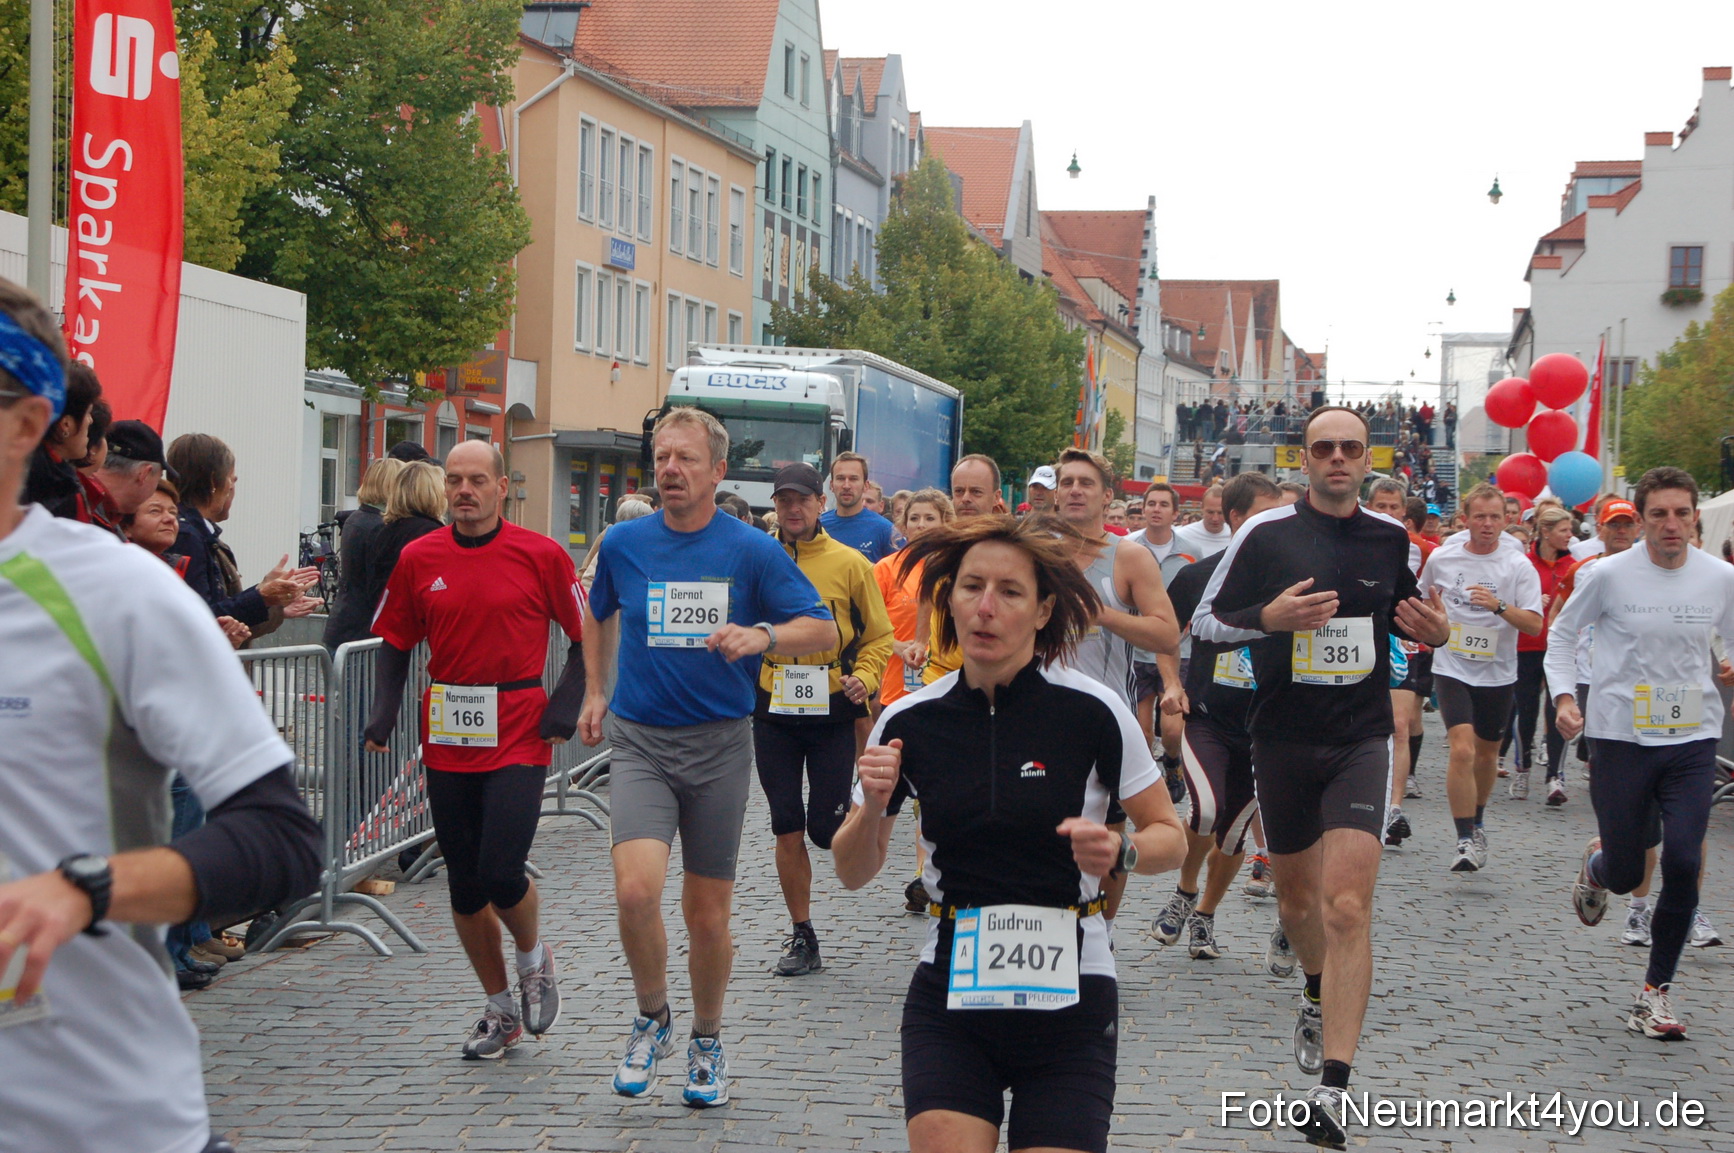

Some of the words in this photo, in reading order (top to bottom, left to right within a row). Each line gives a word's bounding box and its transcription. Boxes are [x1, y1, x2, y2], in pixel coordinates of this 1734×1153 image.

[707, 372, 788, 391] BOCK
[670, 588, 703, 600] Gernot
[652, 605, 658, 615] B
[1624, 604, 1663, 613] Marc
[671, 607, 719, 625] 2296
[1465, 636, 1489, 649] 973
[1323, 645, 1360, 664] 381
[785, 669, 810, 680] Reiner
[445, 690, 485, 704] Normann
[795, 685, 814, 699] 88
[1656, 684, 1690, 705] Rolf
[452, 709, 485, 727] 166
[1671, 705, 1681, 719] 8
[987, 912, 1042, 932] Gudrun
[960, 944, 967, 958] A
[988, 943, 1064, 972] 2407
